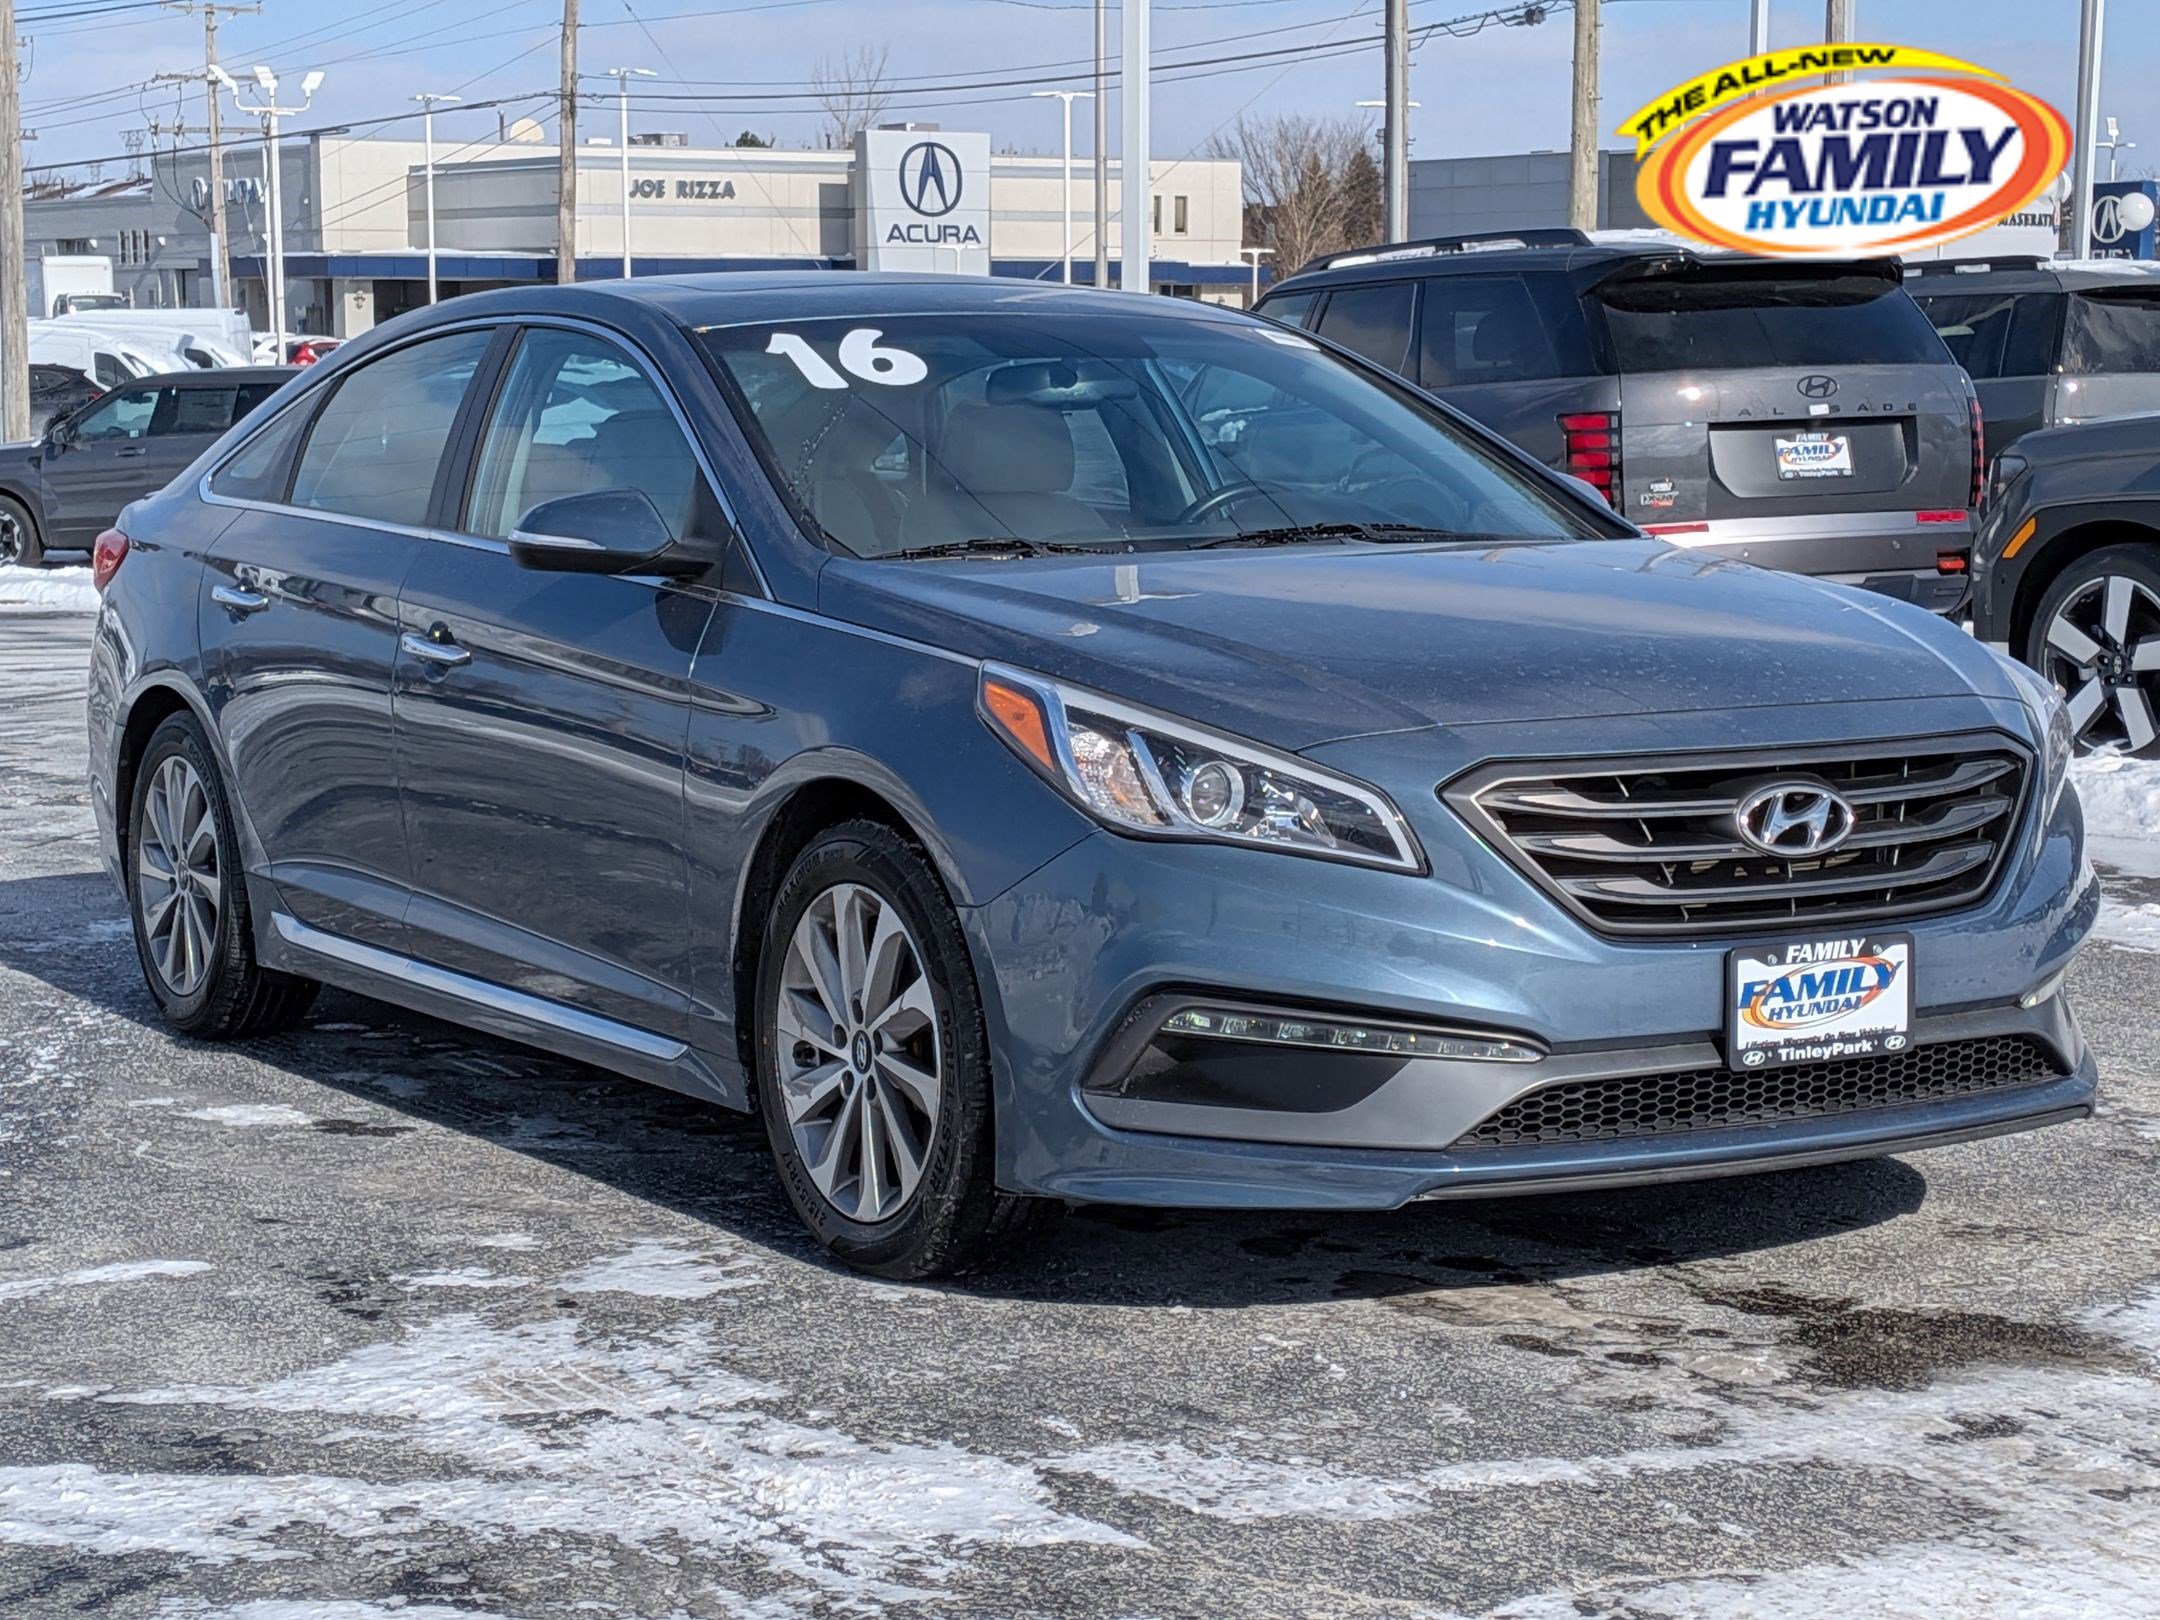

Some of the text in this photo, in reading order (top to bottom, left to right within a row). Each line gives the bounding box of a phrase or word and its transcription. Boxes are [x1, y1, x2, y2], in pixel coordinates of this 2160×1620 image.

[629, 179, 736, 199] JOE RIZZA
[886, 223, 981, 244] ACURA
[765, 328, 928, 389] 16
[1706, 403, 1917, 417] PALSADE
[1785, 938, 1866, 964] FAMILY
[1738, 960, 1905, 1009] FAMILY
[1767, 994, 1863, 1021] HYUNDAI
[1778, 1040, 1873, 1061] TinleyPark
